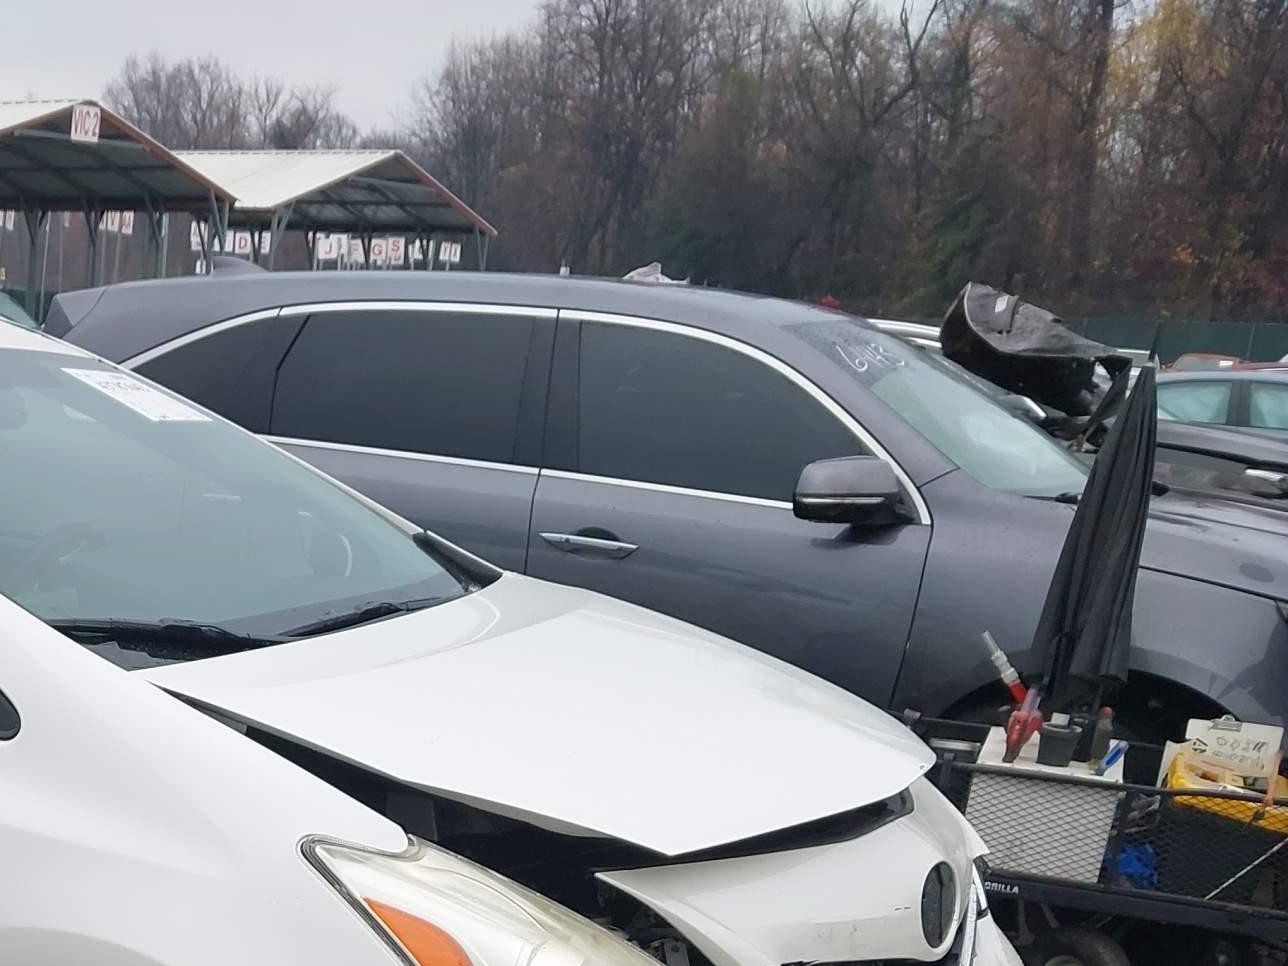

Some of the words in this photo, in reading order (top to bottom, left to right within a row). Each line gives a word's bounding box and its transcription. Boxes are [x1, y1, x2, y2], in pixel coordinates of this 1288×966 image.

[73, 108, 91, 136] VIC
[91, 111, 99, 137] 2
[238, 236, 248, 249] D
[392, 239, 401, 252] S
[372, 244, 383, 257] G
